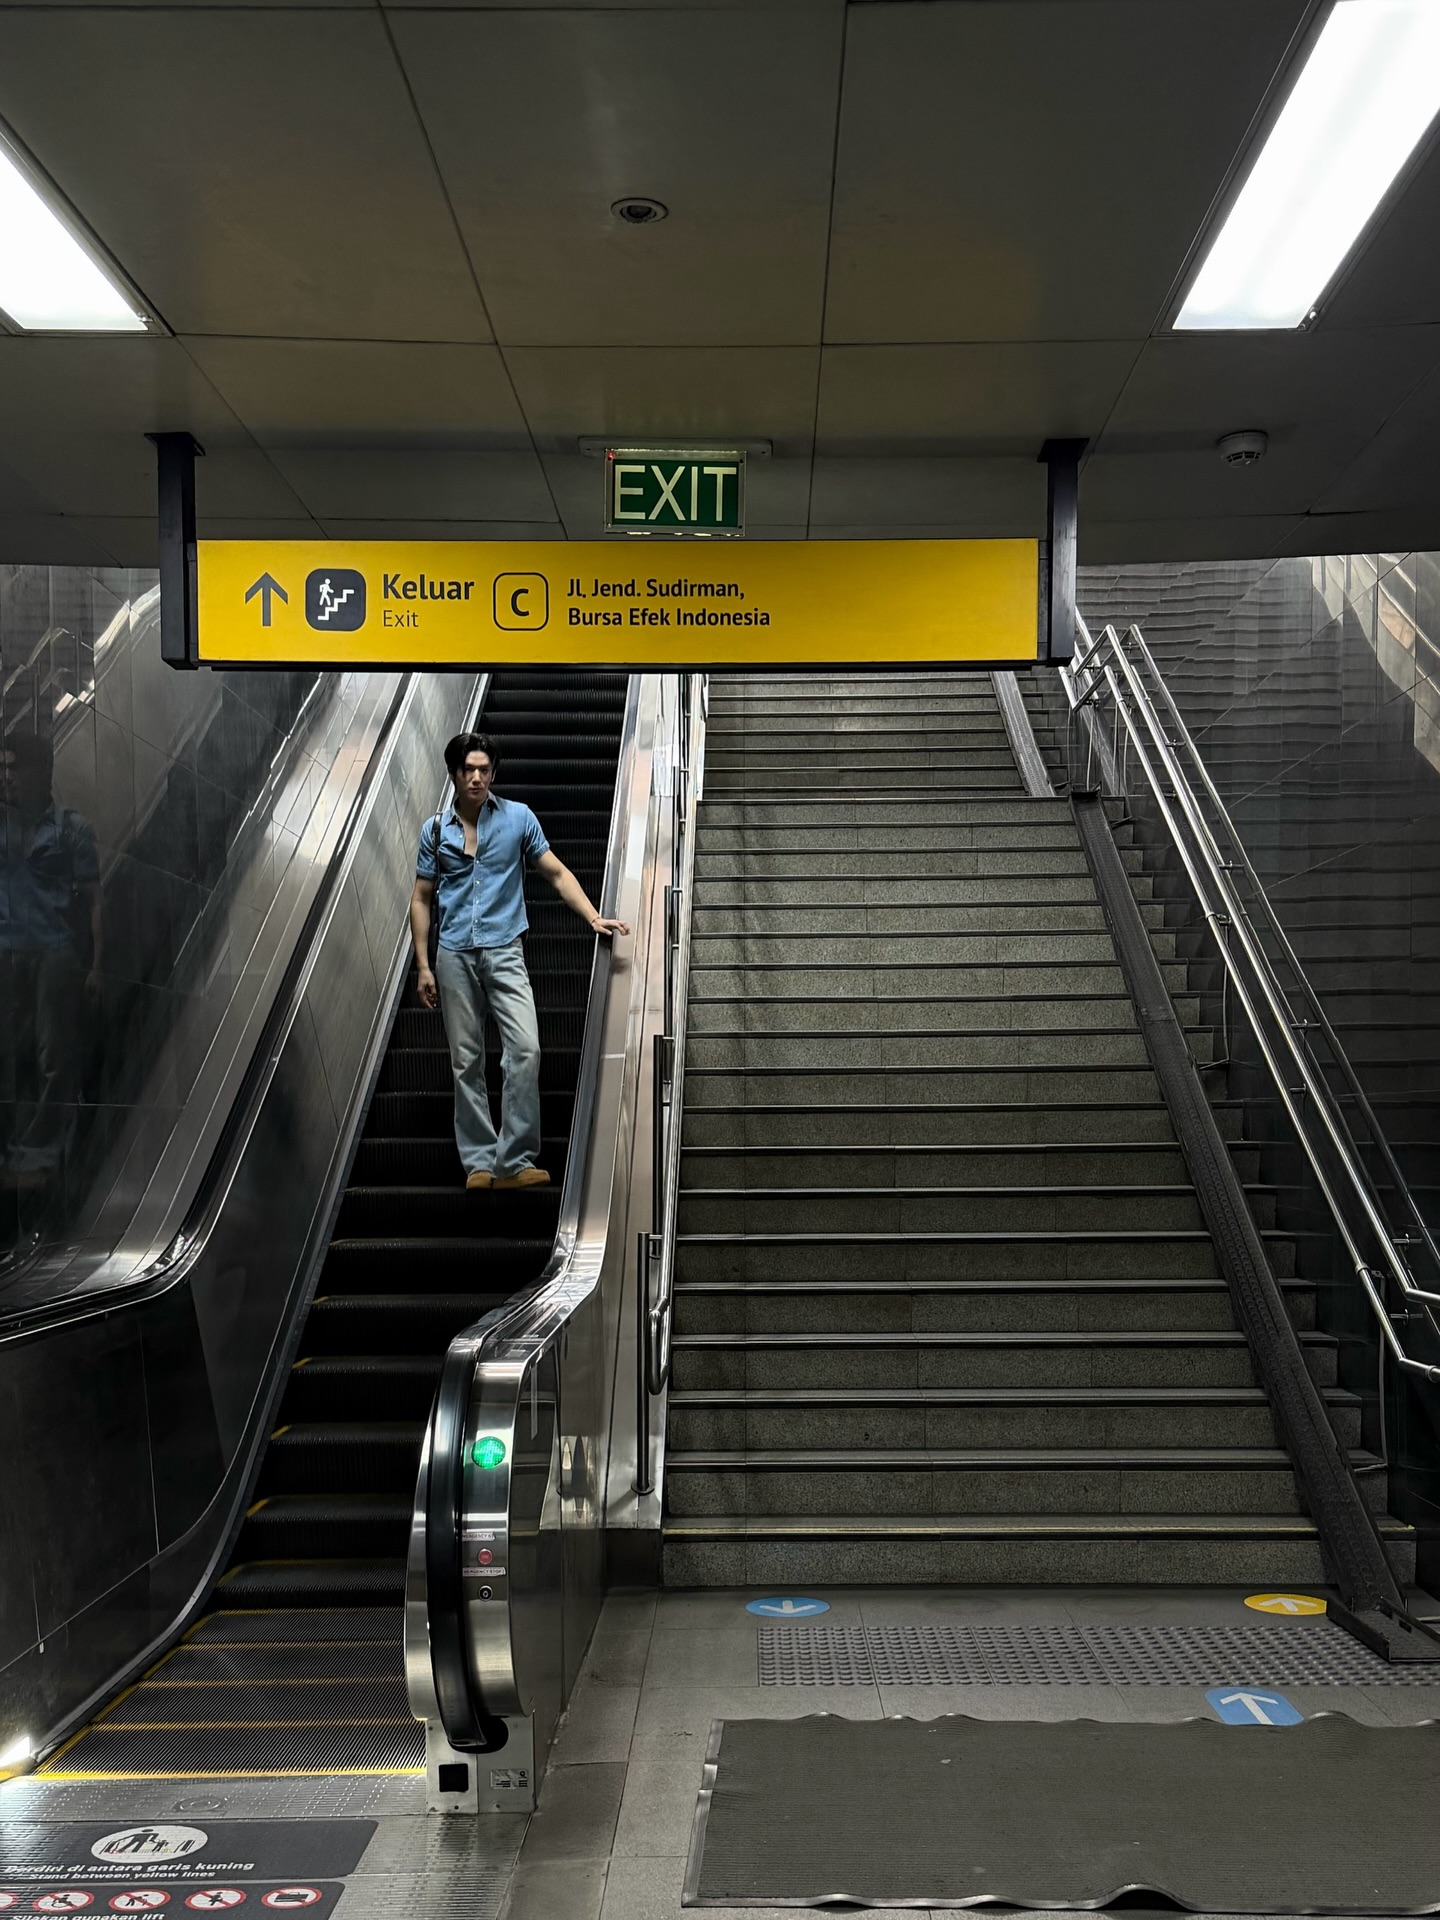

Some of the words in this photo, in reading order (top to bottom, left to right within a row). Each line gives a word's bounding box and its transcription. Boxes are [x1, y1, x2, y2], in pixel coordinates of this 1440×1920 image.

[614, 464, 737, 522] EXIT
[383, 573, 475, 600] Keluar
[567, 578, 587, 599] Jl.
[591, 578, 642, 597] Jend.
[646, 578, 745, 600] Sudirman,
[510, 588, 530, 617] C
[383, 609, 419, 628] Exit
[568, 607, 623, 626] Bursa
[629, 607, 671, 626] Efek
[676, 607, 771, 626] Indonesia
[66, 1864, 86, 1873] di
[87, 1863, 143, 1872] antara
[147, 1862, 191, 1872] garis
[193, 1861, 255, 1872] kuning
[70, 1872, 130, 1880] between
[133, 1871, 180, 1880] yellow
[181, 1870, 216, 1878] lines
